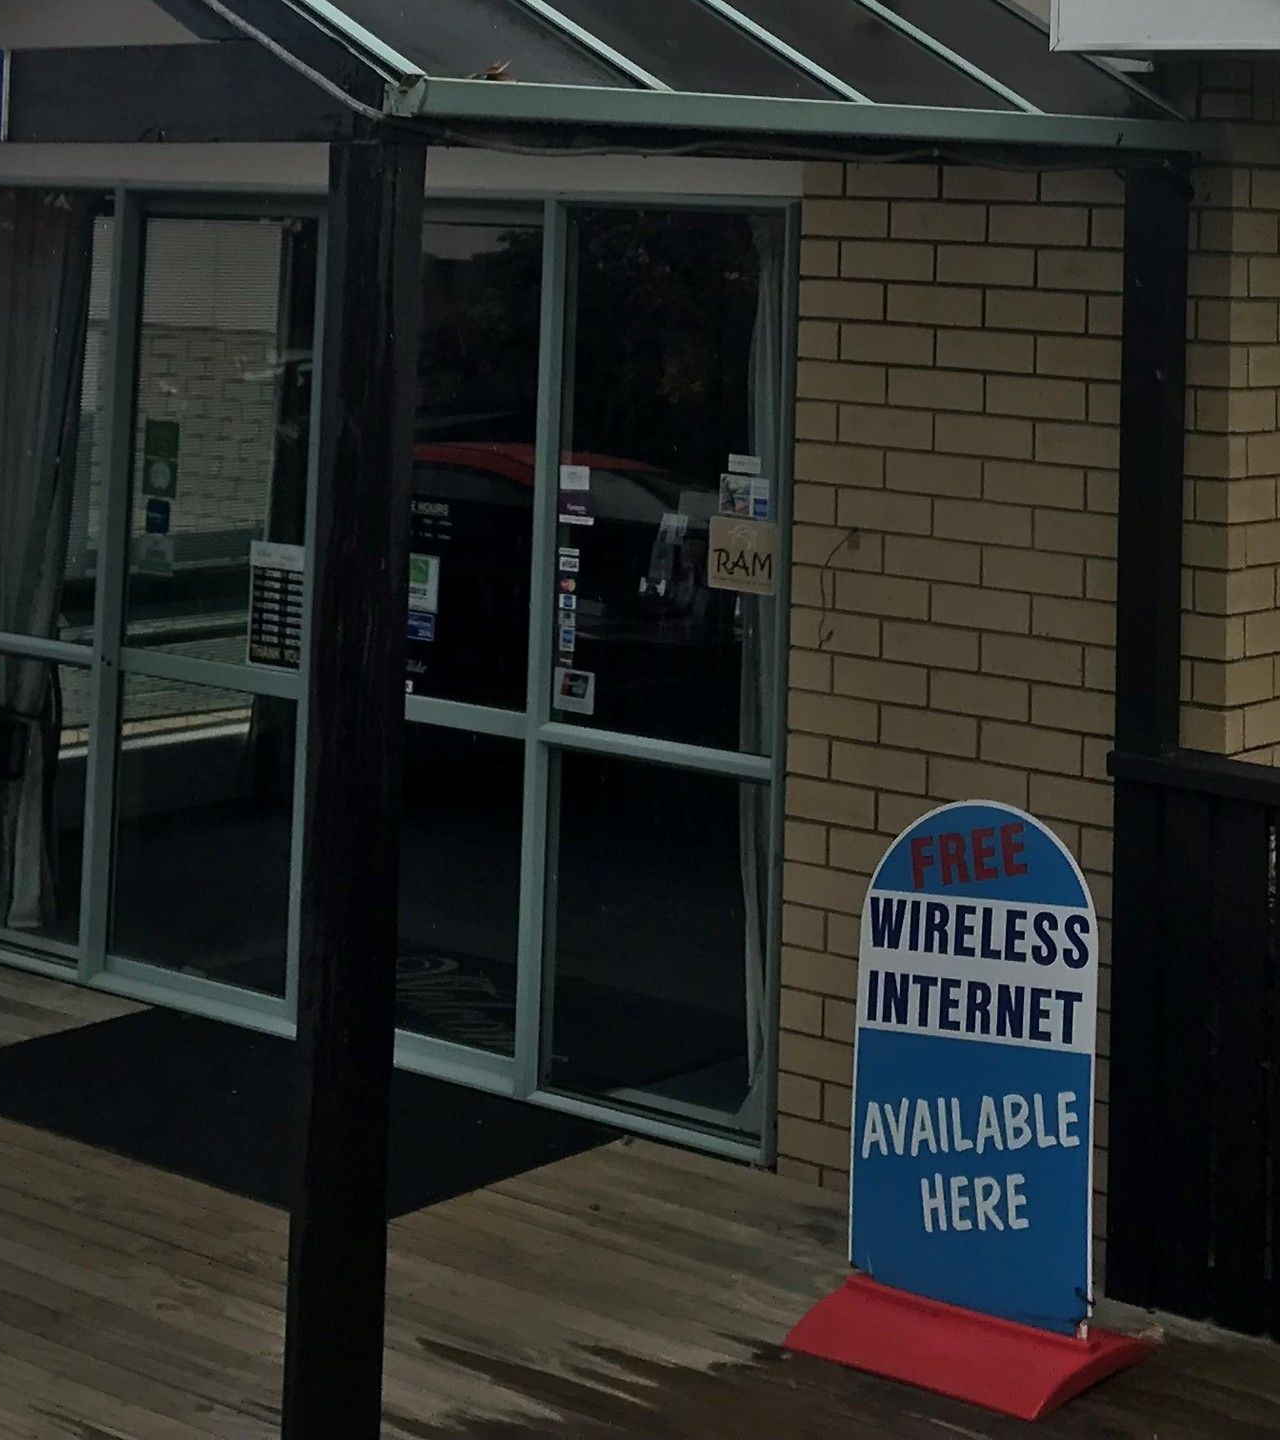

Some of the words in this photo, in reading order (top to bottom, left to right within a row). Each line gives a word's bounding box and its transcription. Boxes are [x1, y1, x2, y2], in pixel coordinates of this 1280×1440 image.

[713, 548, 771, 579] RAM
[912, 823, 1028, 889] FREE
[870, 897, 1090, 969] WIRELESS
[868, 970, 1083, 1044] INTERNET
[862, 1091, 1080, 1159] AVAILABLE
[920, 1174, 1030, 1233] HERE
